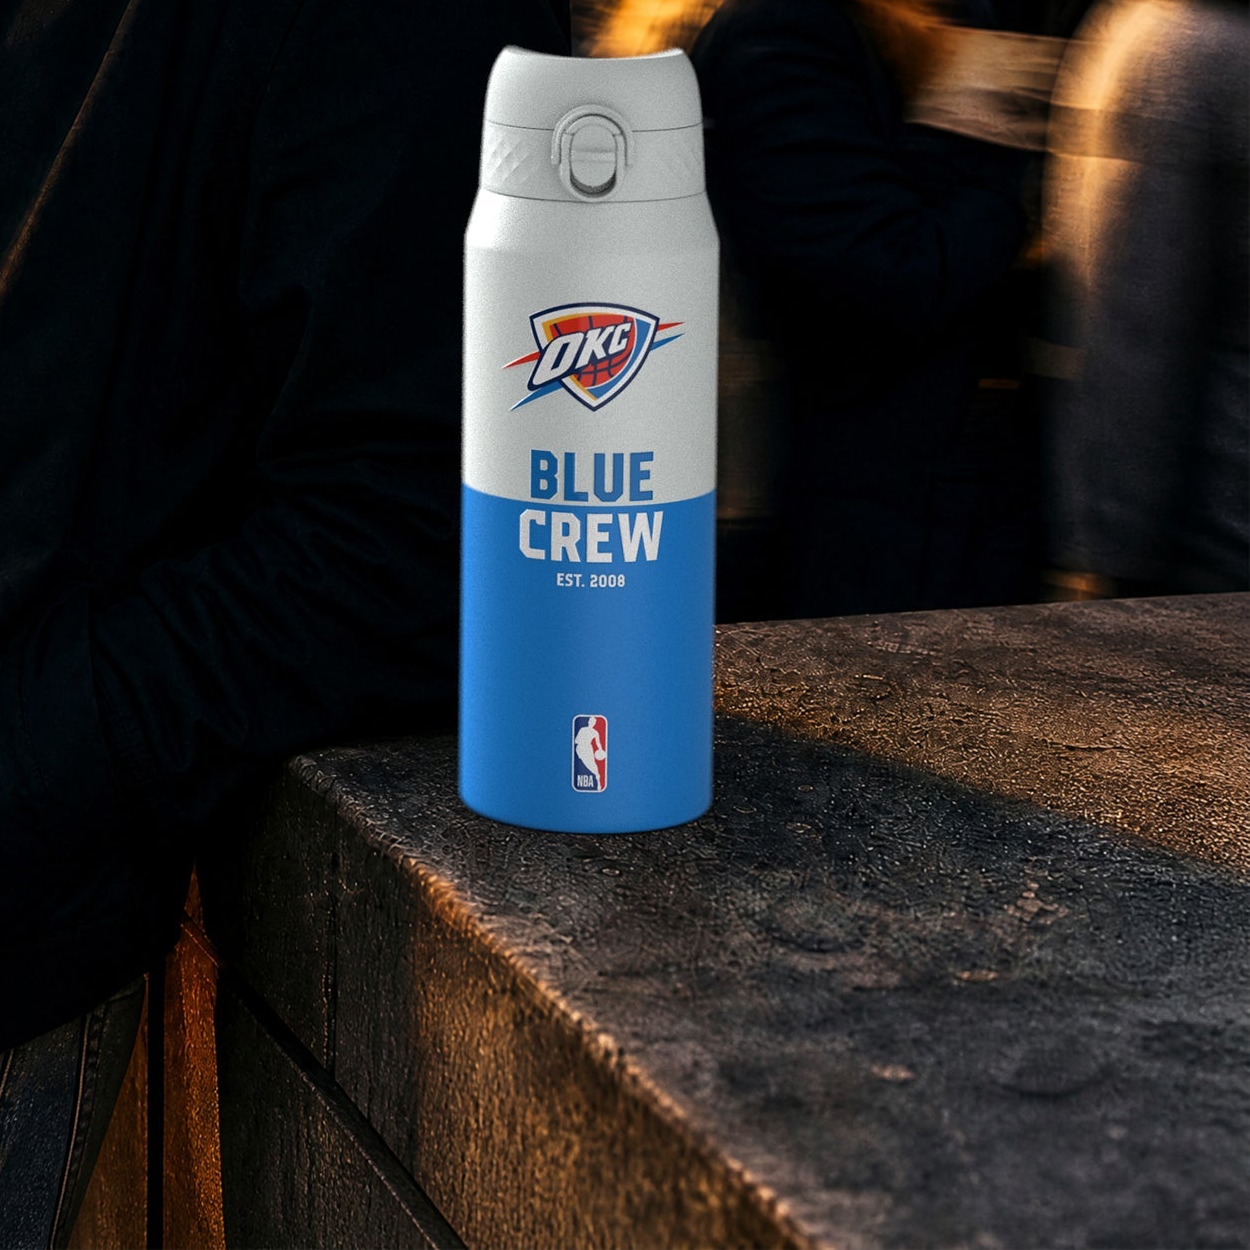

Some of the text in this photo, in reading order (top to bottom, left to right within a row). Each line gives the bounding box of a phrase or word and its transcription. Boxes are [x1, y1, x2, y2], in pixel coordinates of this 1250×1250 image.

[532, 322, 632, 386] OKC
[530, 449, 654, 503] BLUE
[519, 508, 664, 563] CREW
[556, 573, 626, 588] EST. 2008
[576, 774, 594, 788] NBA
